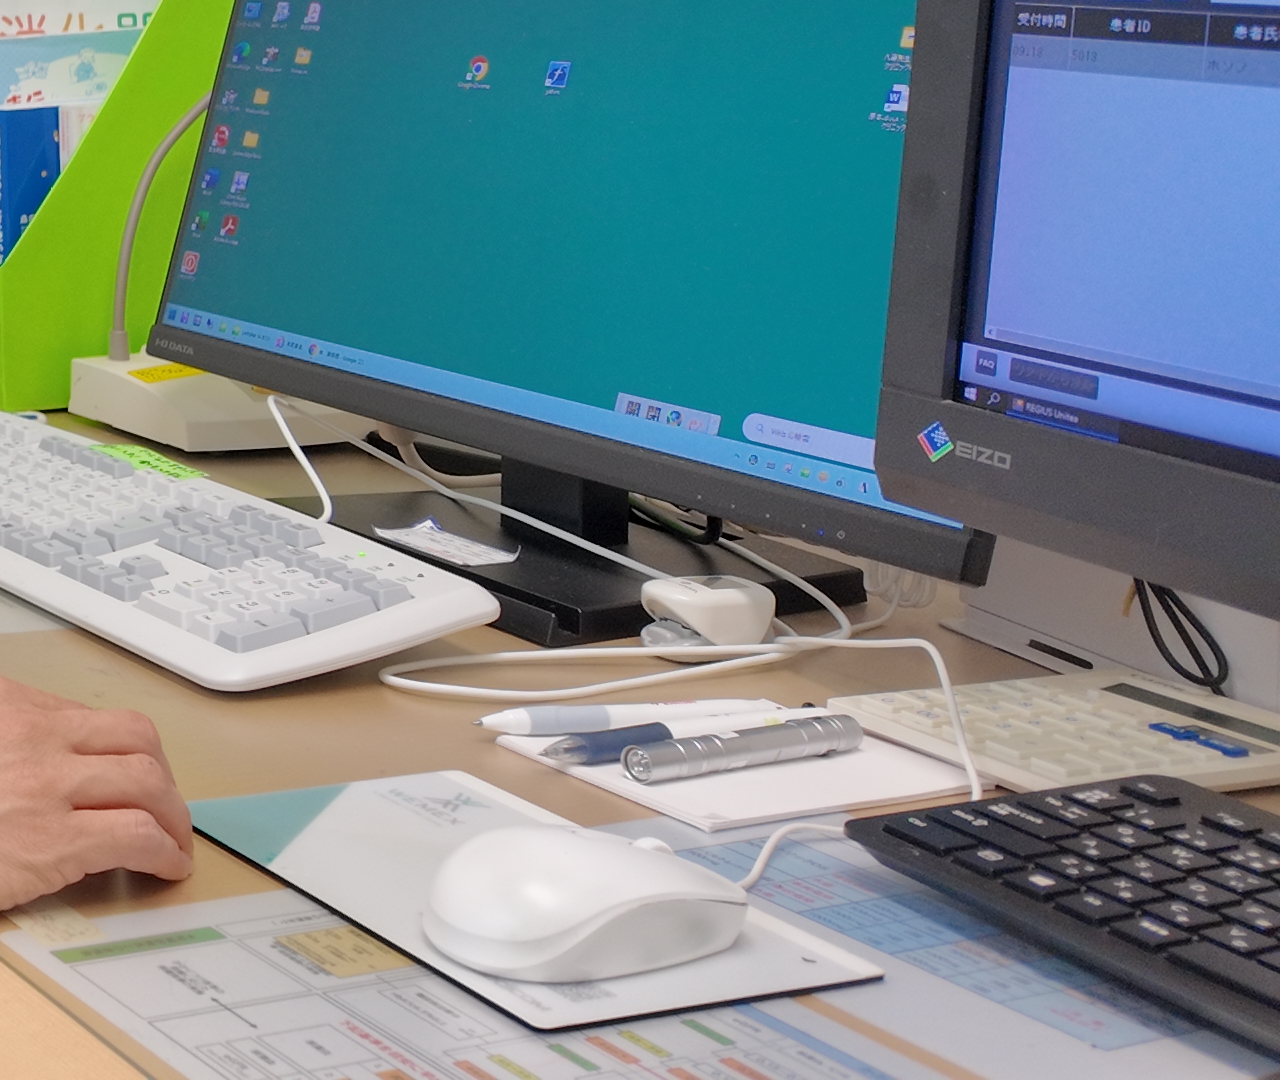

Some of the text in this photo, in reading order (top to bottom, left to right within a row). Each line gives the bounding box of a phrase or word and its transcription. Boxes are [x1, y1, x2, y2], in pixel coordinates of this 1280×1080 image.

[1017, 13, 1067, 29] 受付時間
[1109, 17, 1152, 34] 患者ID
[168, 341, 195, 356] DATA
[978, 357, 996, 369] FAQ
[954, 441, 1012, 470] EIZO
